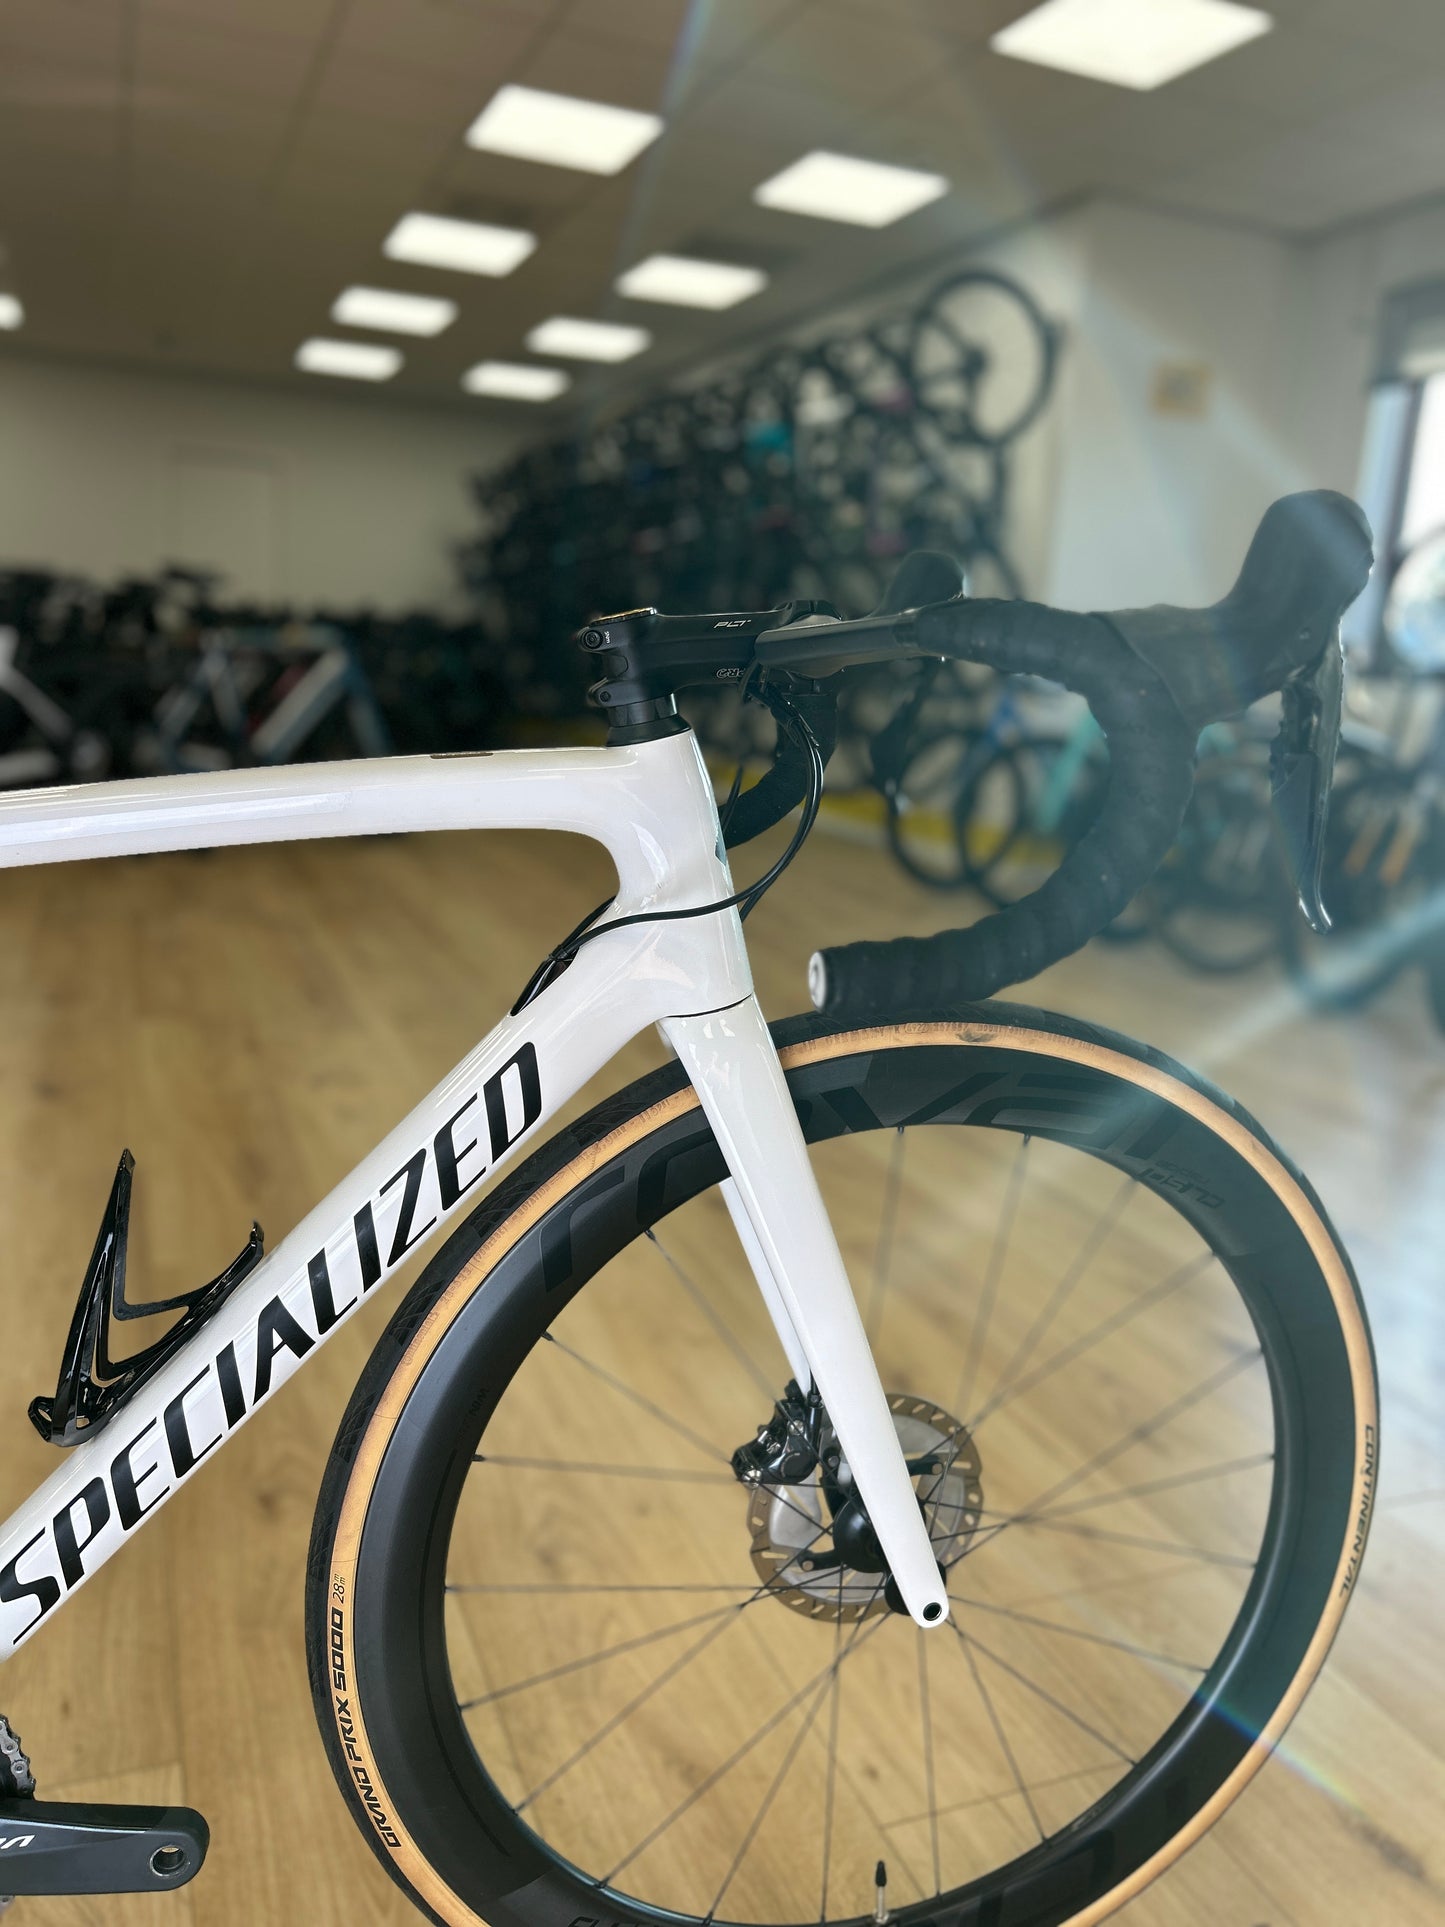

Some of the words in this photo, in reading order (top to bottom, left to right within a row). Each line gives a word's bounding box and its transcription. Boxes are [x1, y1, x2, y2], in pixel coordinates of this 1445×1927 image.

[0, 1041, 542, 1646] SPECIALIZED
[1338, 1424, 1374, 1598] CONTINENTAL
[331, 1606, 347, 1692] 5000
[335, 1696, 362, 1762] PRIX
[352, 1766, 401, 1848] GRAND
